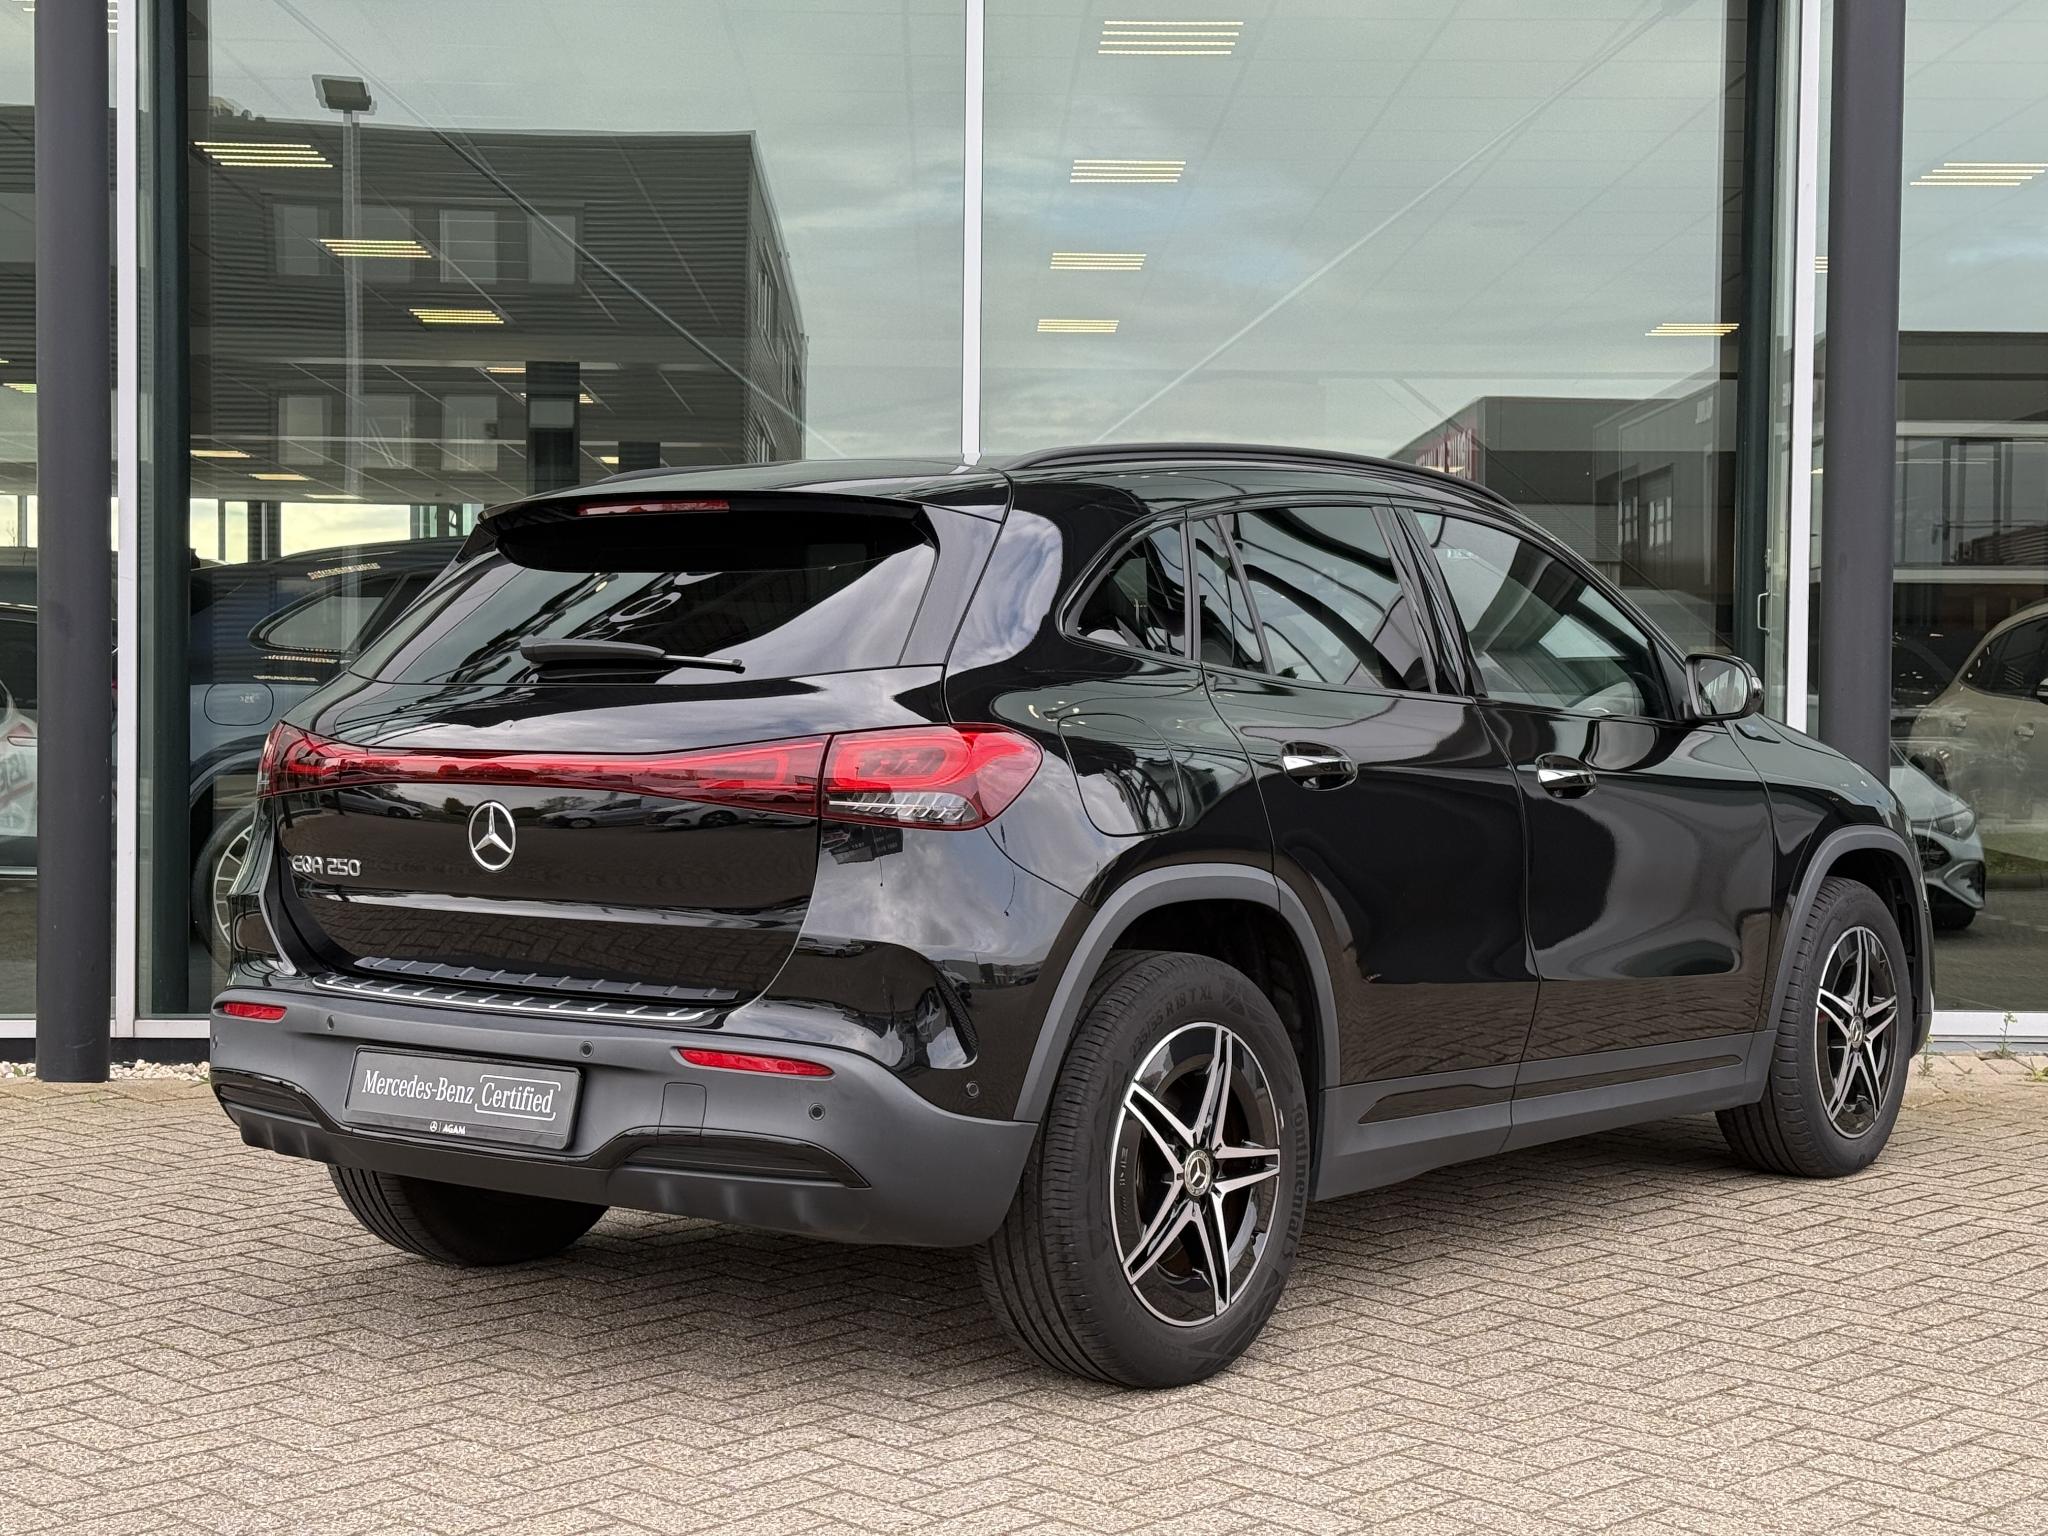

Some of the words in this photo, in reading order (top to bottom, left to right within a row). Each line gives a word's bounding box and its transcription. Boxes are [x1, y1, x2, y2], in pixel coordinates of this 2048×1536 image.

[291, 855, 324, 874] EQA
[326, 858, 361, 877] 250
[361, 1069, 475, 1105] Mercedes-Benz
[482, 1082, 554, 1113] Certified
[1287, 1103, 1309, 1243] Continental
